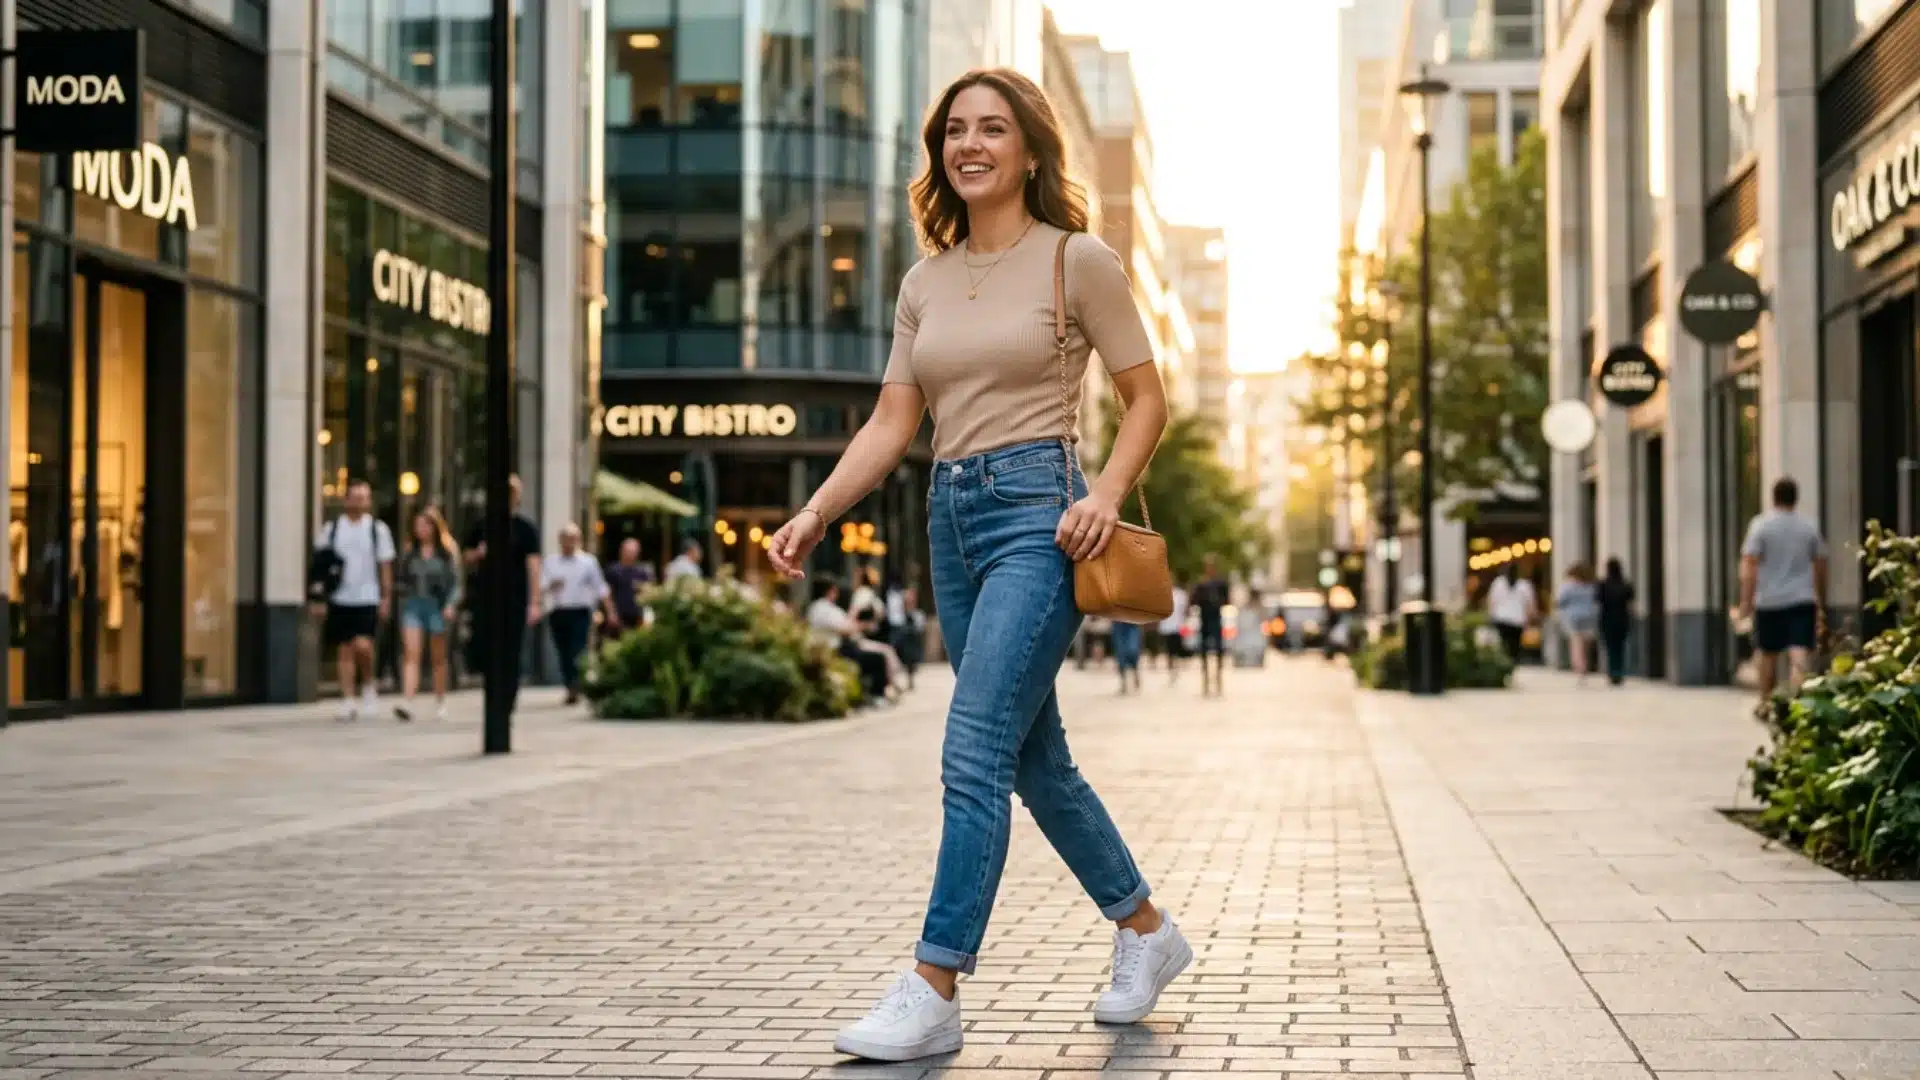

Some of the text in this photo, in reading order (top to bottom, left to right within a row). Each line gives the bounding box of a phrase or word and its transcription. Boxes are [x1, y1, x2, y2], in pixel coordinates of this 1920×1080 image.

[26, 74, 126, 105] MODA
[72, 141, 197, 232] MODA
[1831, 172, 1873, 251] OAK
[373, 248, 491, 336] CITY BISTR
[605, 404, 678, 437] CITY
[683, 404, 796, 437] BISTRO
